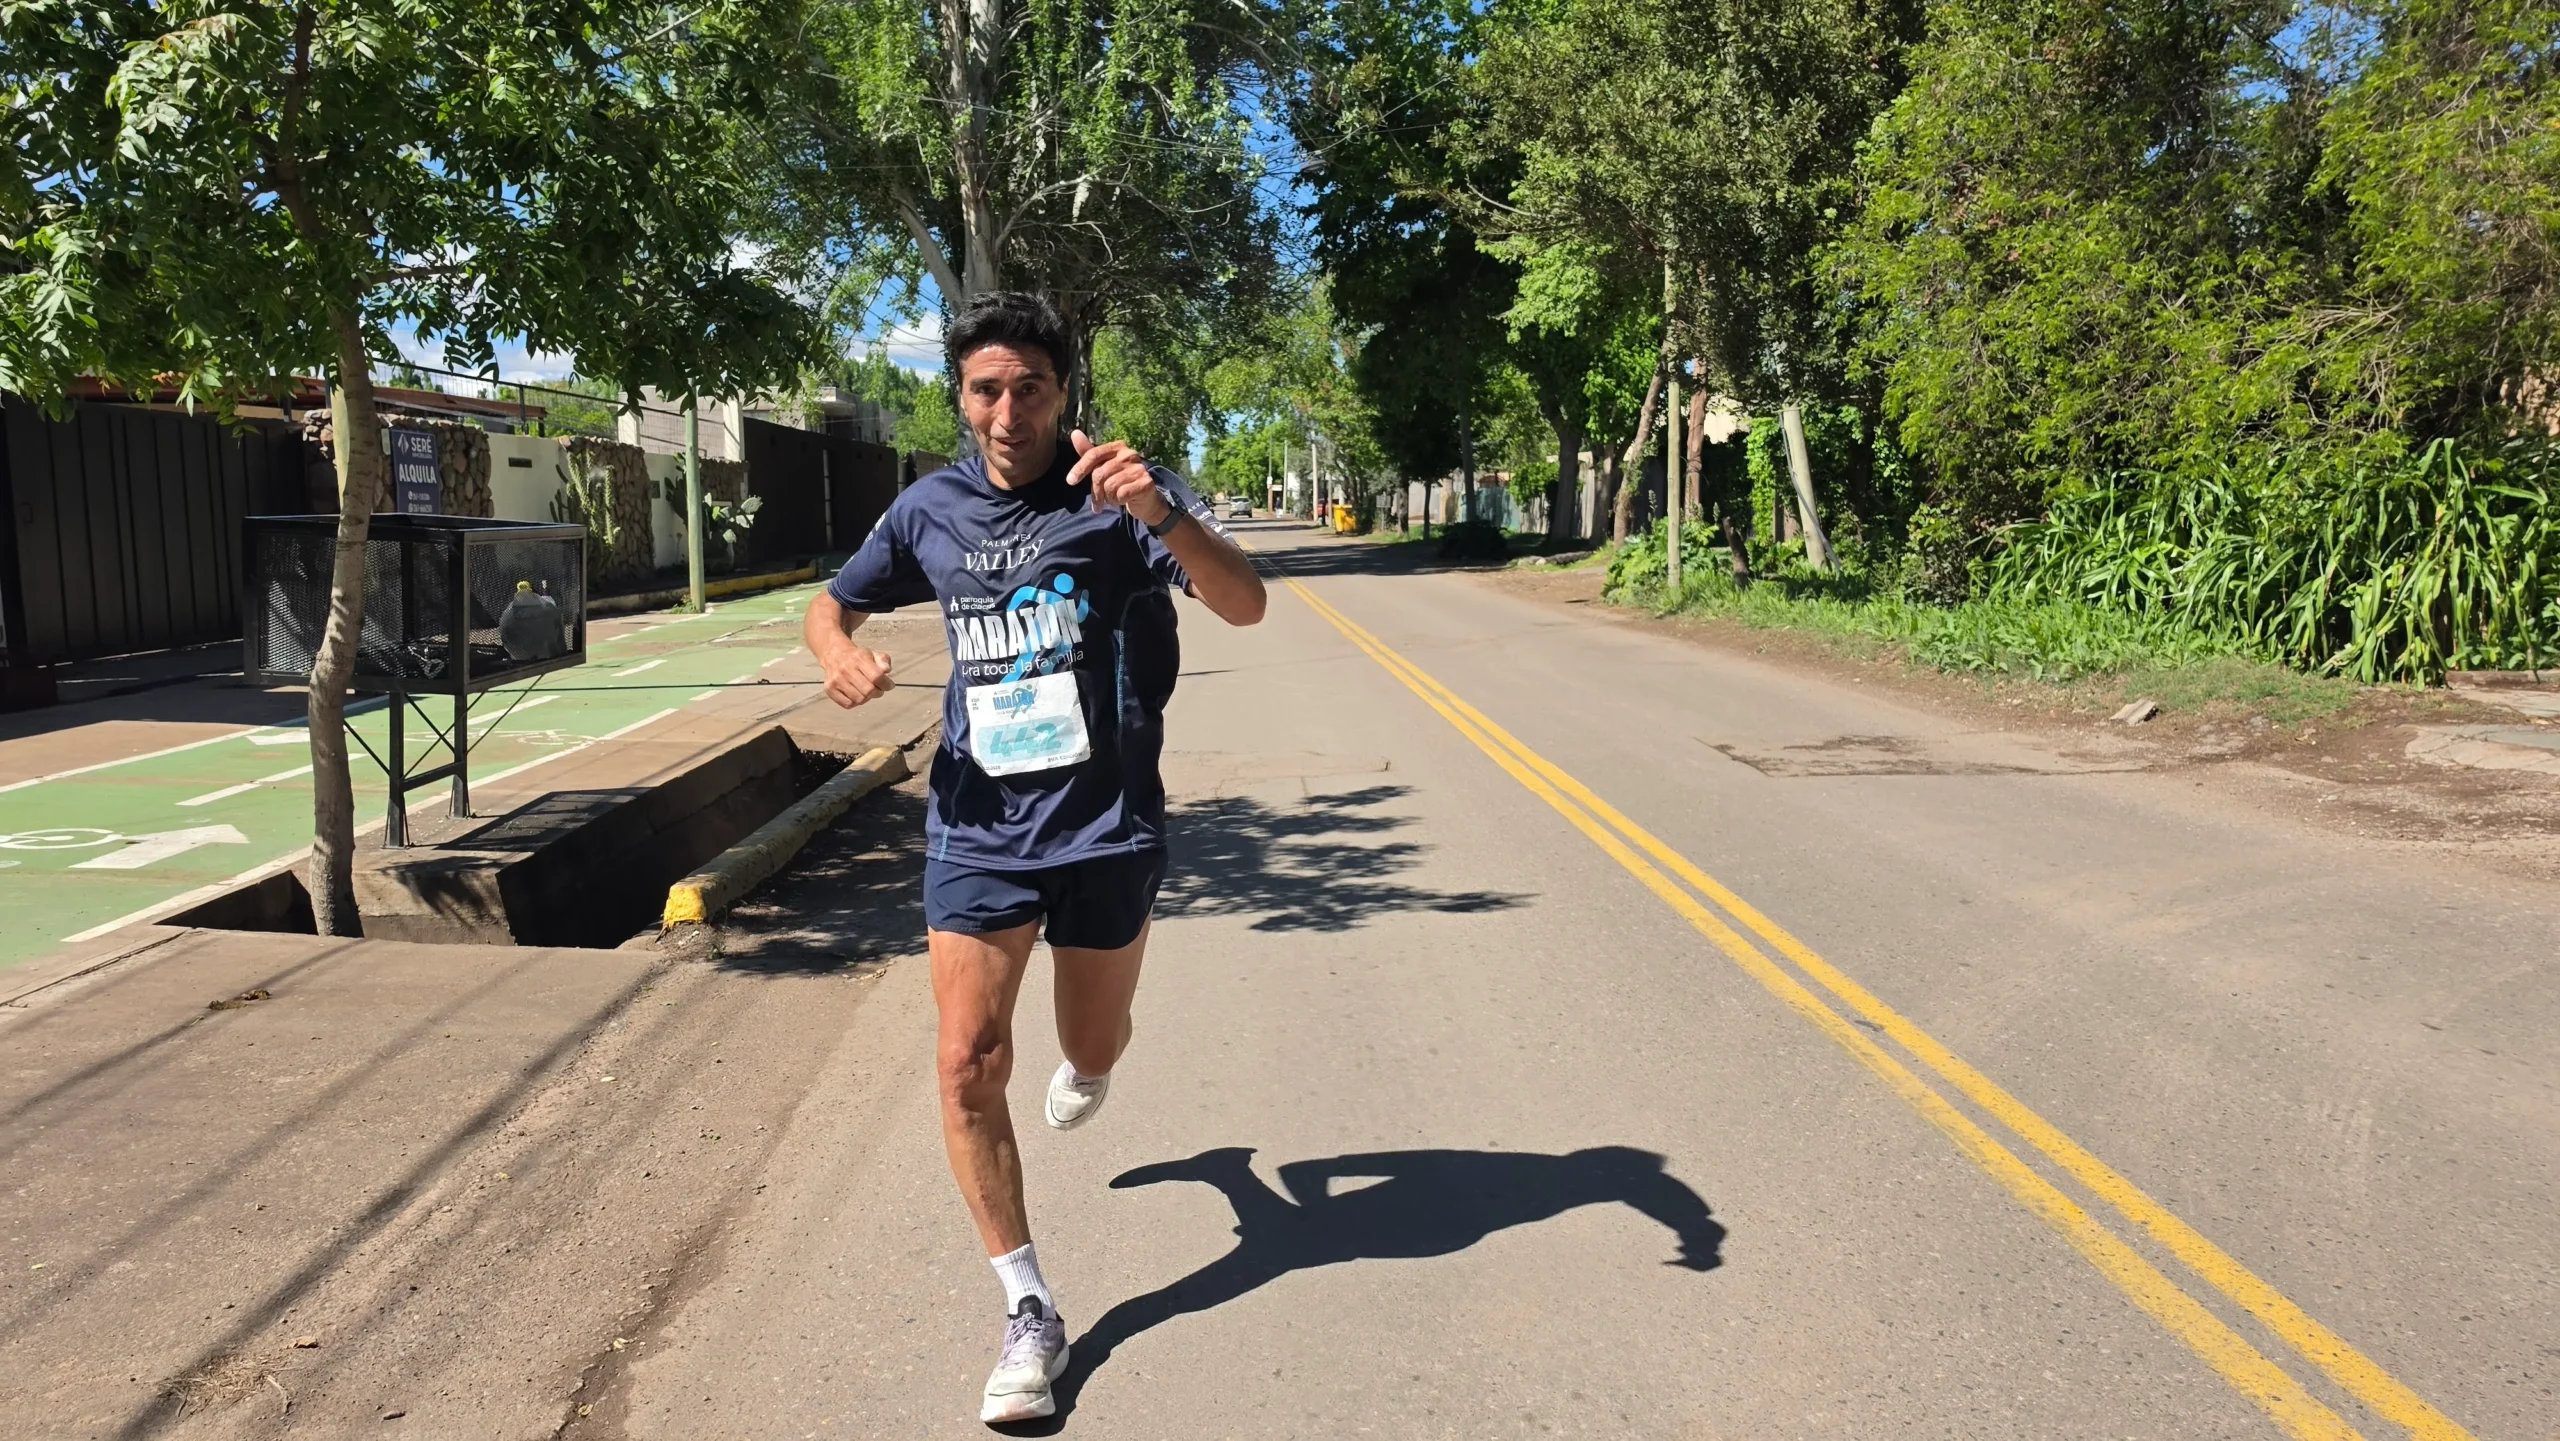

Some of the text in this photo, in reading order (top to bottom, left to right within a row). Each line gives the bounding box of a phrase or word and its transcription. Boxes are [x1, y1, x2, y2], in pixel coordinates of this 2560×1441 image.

[411, 435, 432, 453] SERÉ
[399, 463, 437, 484] ALQUILA
[965, 539, 1044, 571] VALLEY
[960, 596, 994, 605] parroquia
[984, 661, 1017, 676] toda
[1021, 659, 1033, 672] la
[1036, 649, 1084, 669] familia
[989, 722, 1062, 757] 442
